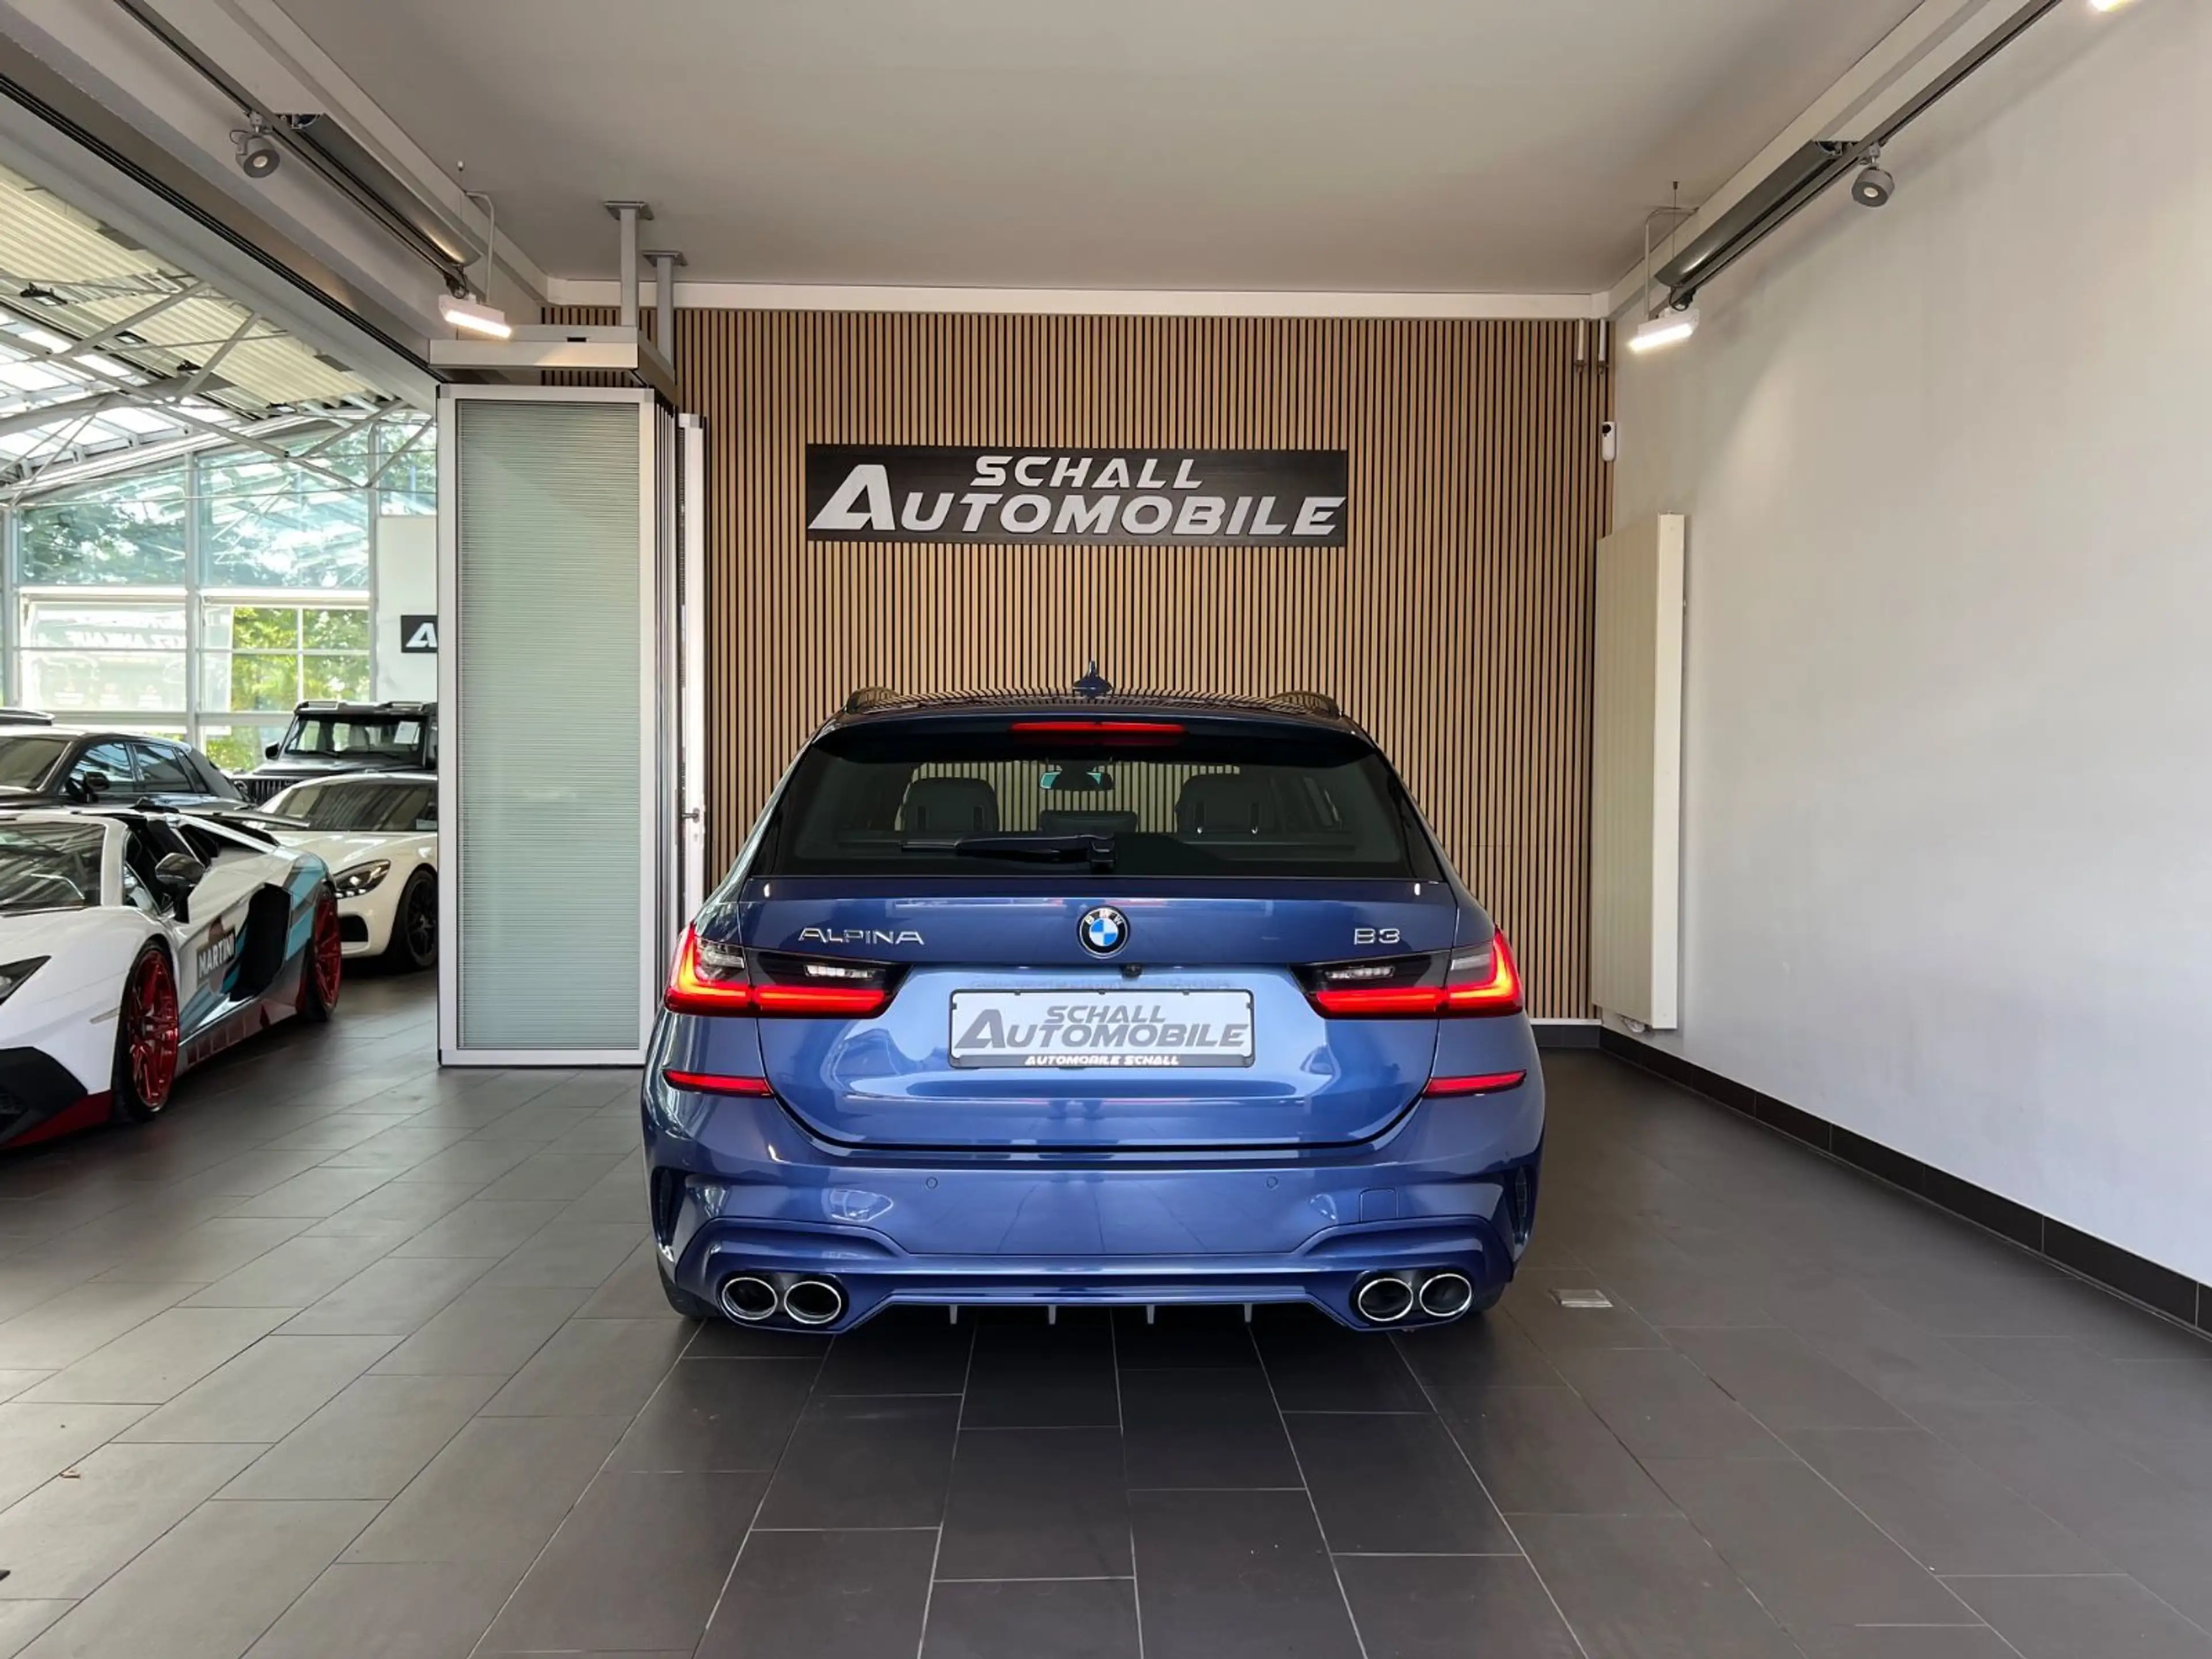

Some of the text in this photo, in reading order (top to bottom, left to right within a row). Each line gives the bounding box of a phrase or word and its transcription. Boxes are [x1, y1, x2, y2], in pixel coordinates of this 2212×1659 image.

[971, 456, 1205, 490] SCHALL
[808, 464, 1346, 536] AUTOMOBILE
[798, 927, 925, 945] ALPINA
[1354, 928, 1400, 945] B3
[1044, 1005, 1165, 1024] SCHALL
[954, 1009, 1249, 1048] AUTOMOBILE
[1024, 1055, 1179, 1066] AUTOMOBILE SCHALL
